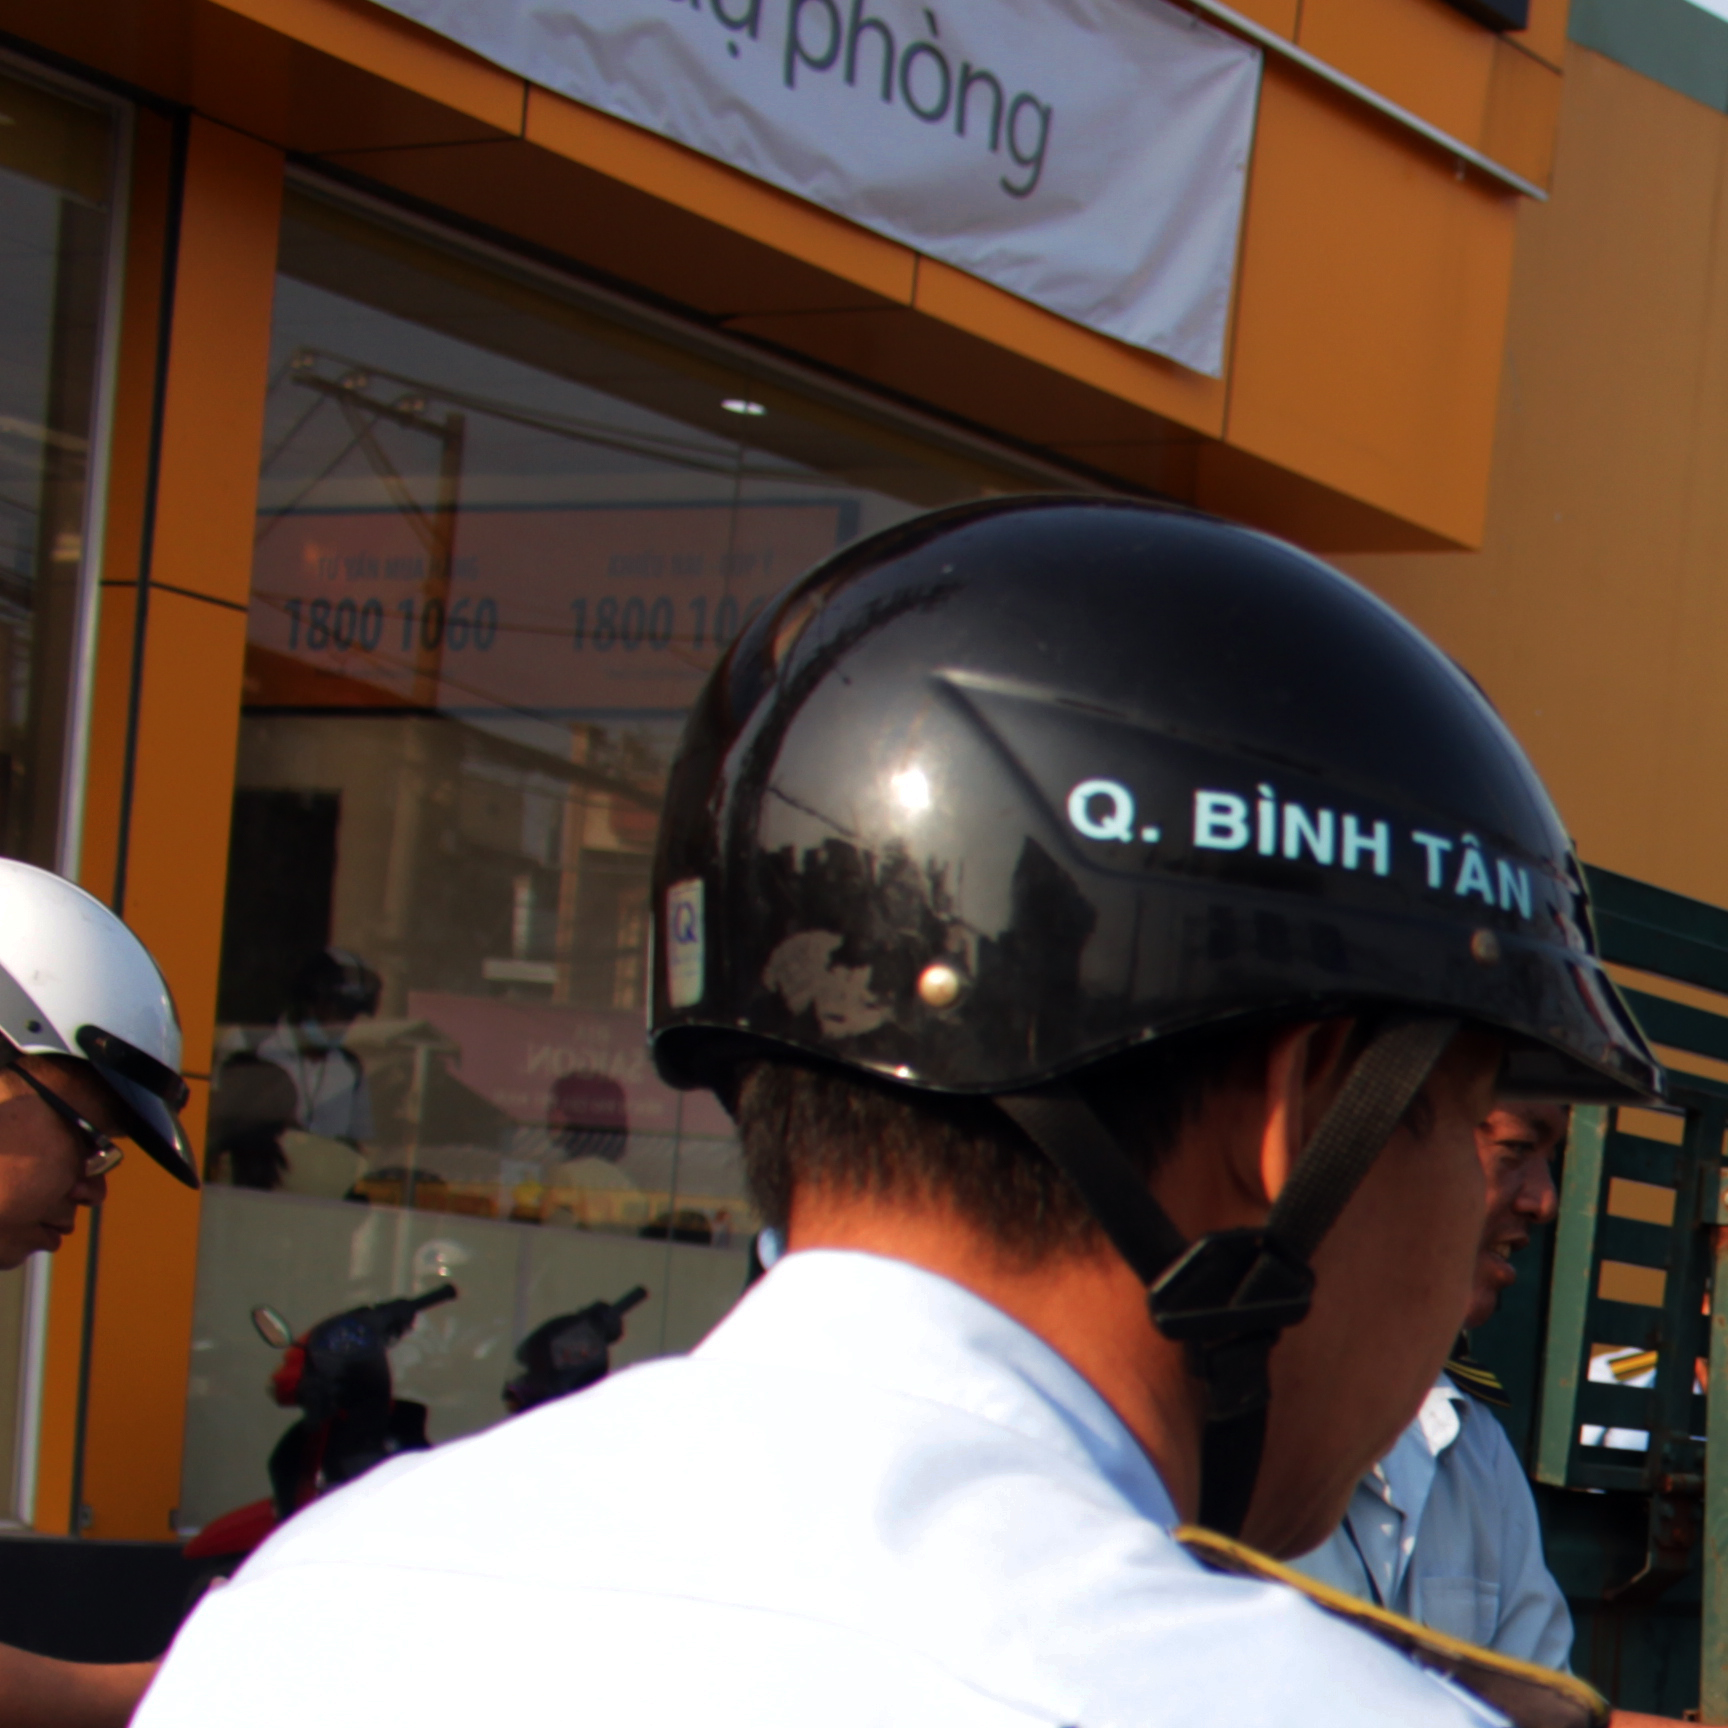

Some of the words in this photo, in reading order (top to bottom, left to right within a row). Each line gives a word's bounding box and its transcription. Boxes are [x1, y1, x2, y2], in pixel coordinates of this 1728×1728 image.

[784, 0, 1052, 199] phòng
[284, 597, 384, 652] 1800
[396, 597, 499, 652] 1060
[571, 595, 674, 652] 1800
[1066, 777, 1160, 843] Q.
[1193, 783, 1389, 876] BÌNH
[1411, 831, 1531, 920] TÂN
